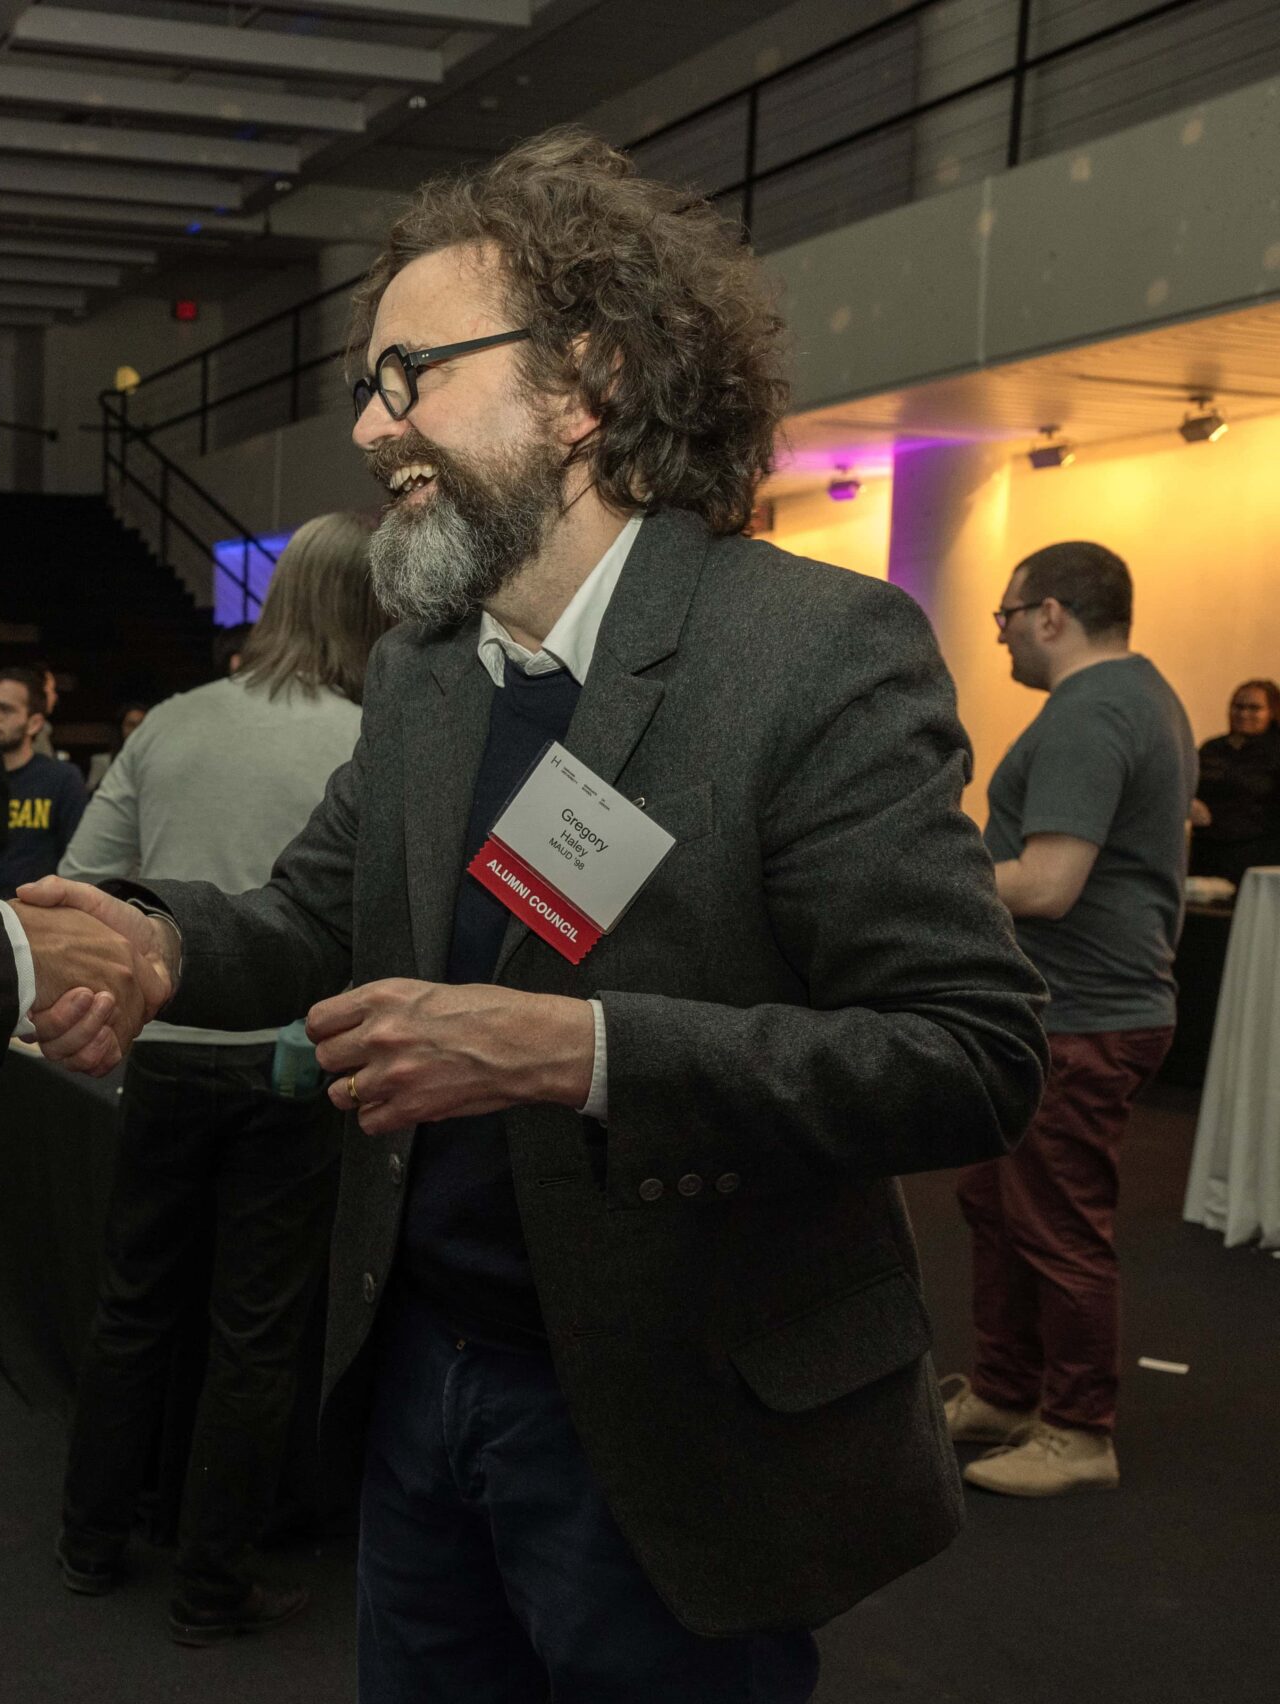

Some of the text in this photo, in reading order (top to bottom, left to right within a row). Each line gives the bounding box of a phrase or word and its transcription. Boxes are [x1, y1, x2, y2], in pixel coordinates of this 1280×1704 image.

[551, 755, 562, 768] H
[560, 829, 589, 858] Haley
[561, 808, 609, 853] Gregory
[548, 837, 585, 871] MAUD '98
[486, 859, 579, 943] ALUMNI COUNCIL
